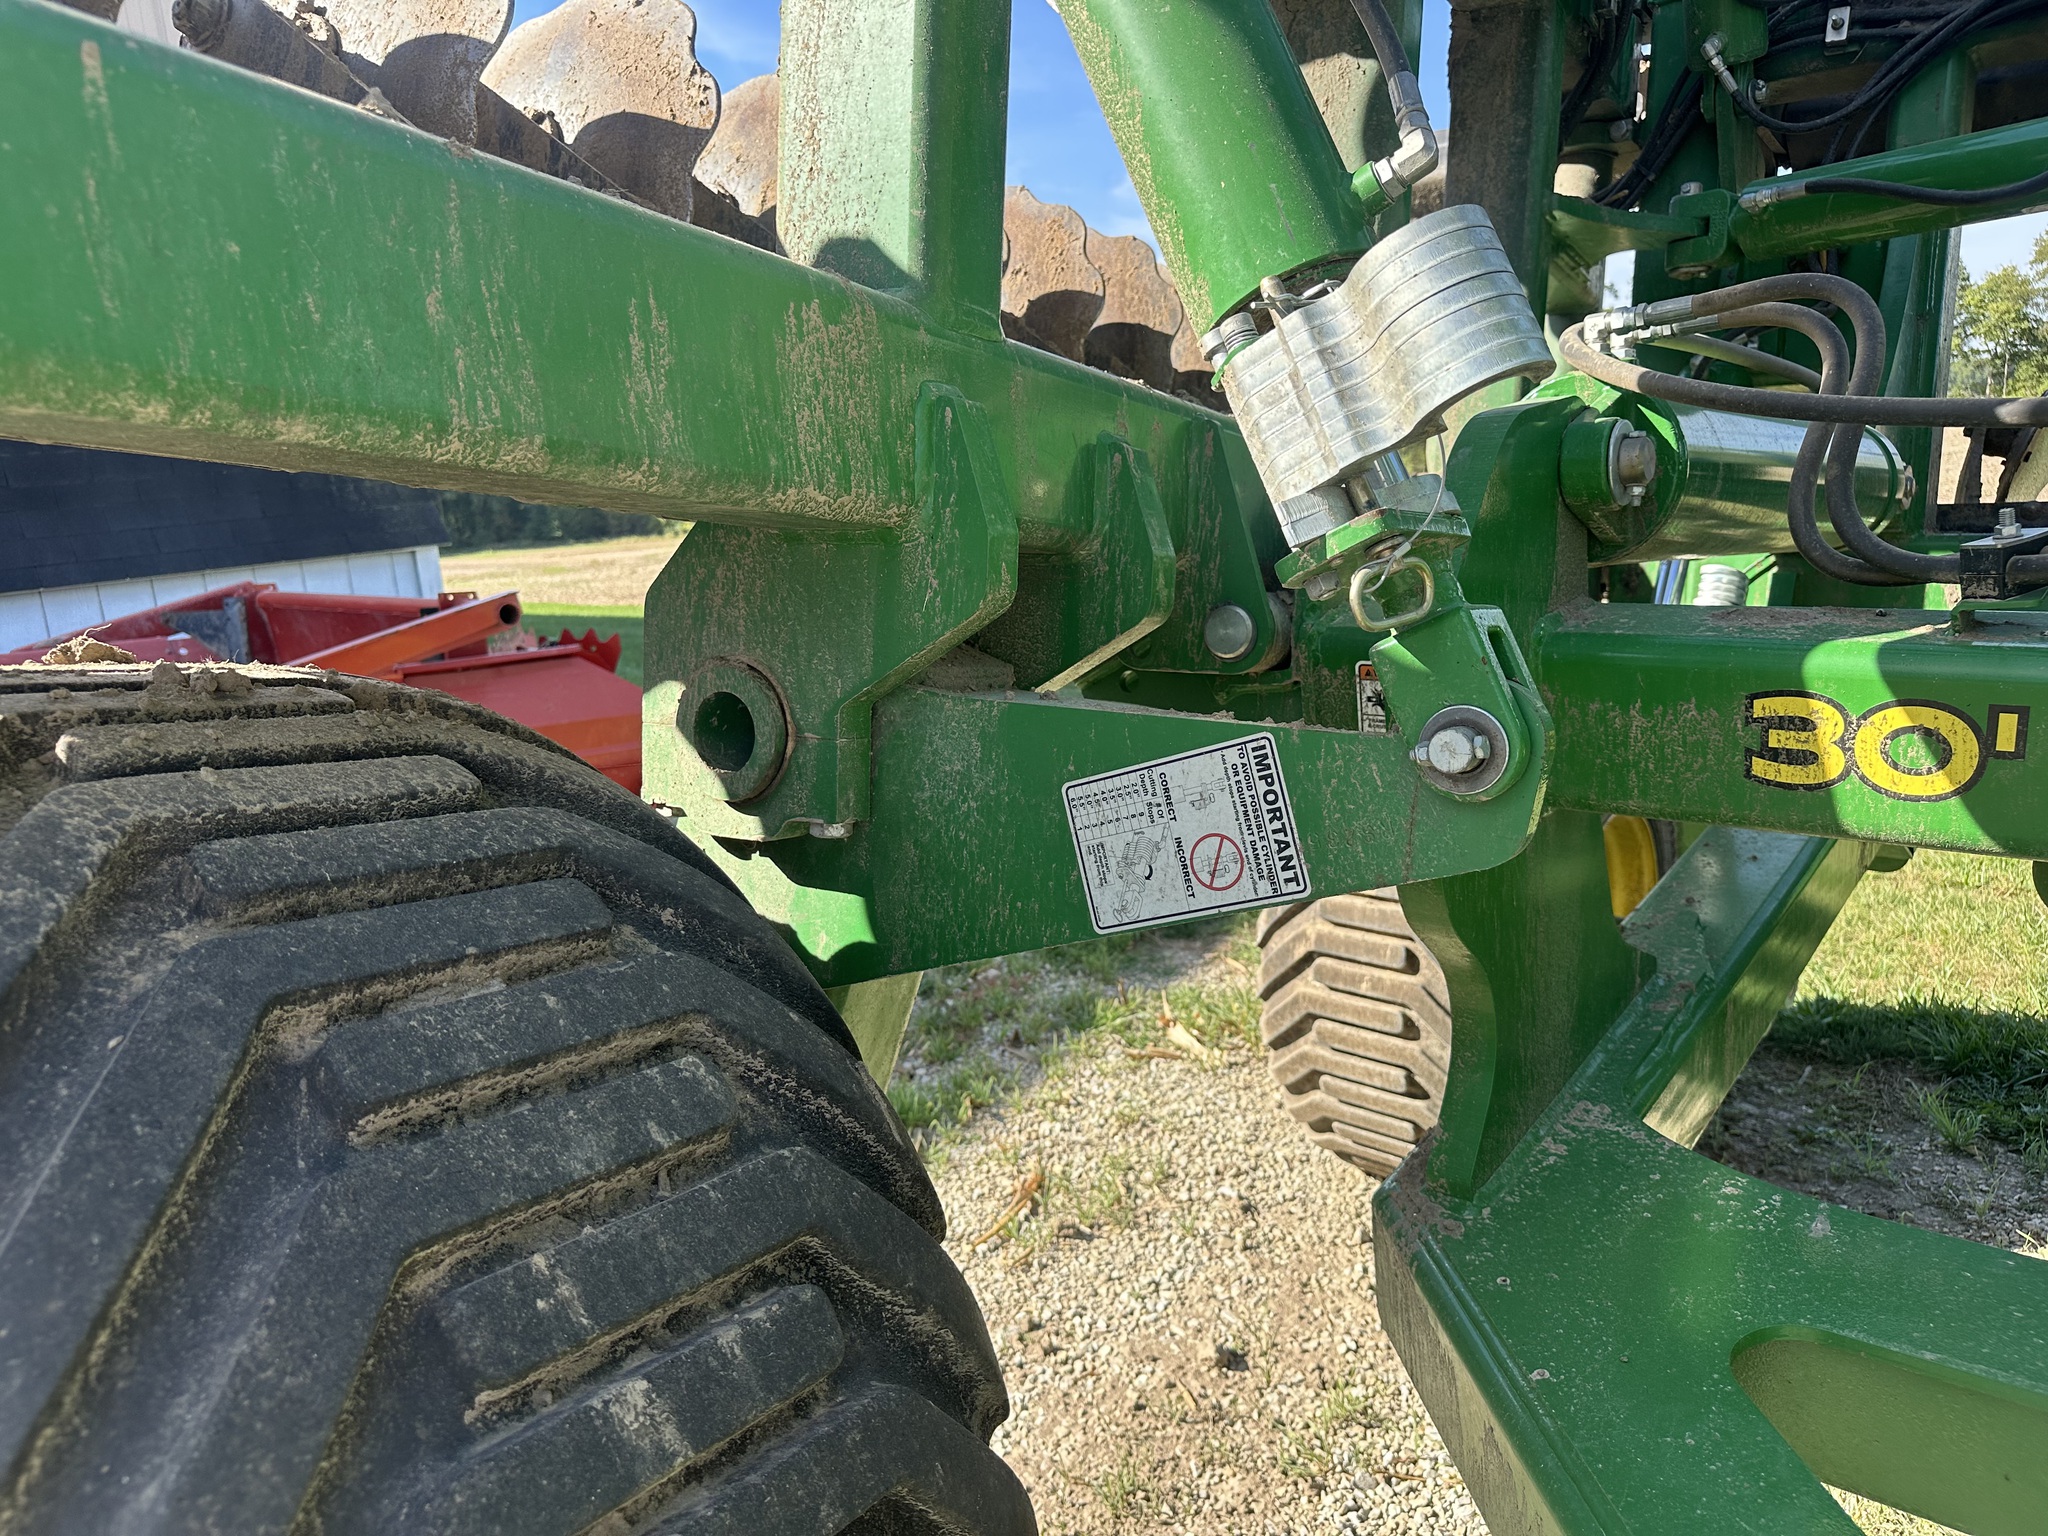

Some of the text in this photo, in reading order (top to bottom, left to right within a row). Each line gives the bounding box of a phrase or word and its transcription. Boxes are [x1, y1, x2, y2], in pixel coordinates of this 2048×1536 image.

[1744, 689, 2030, 802] 30'
[1139, 773, 1149, 797] Depth
[1146, 801, 1155, 824] Stops
[1147, 768, 1158, 797] Cutting
[1159, 772, 1177, 822] CORRECT
[1223, 766, 1231, 782] depth
[1232, 800, 1240, 822] starting
[1240, 836, 1248, 853] clevis
[1157, 809, 1165, 819] Of
[1231, 763, 1266, 881] OR EQUIPMENT DAMAGE
[1237, 746, 1279, 894] TO AVOID POSSIBLE CYLINDER
[1251, 744, 1301, 887] IMPORTANT
[1174, 837, 1196, 899] INCORRECT
